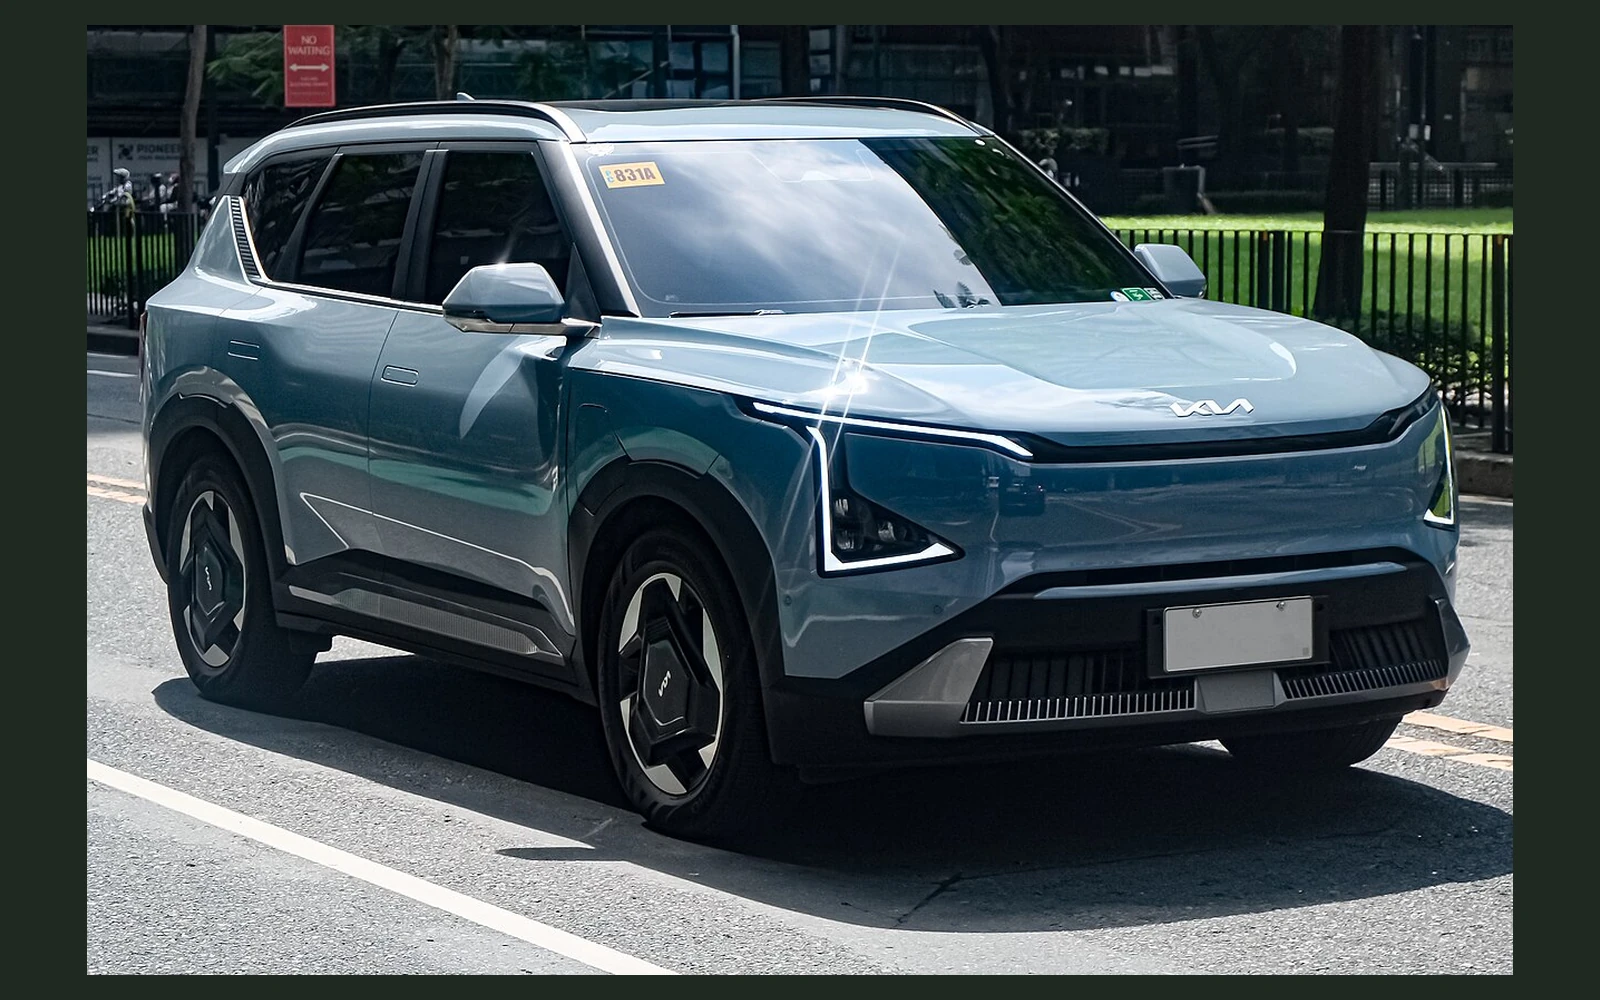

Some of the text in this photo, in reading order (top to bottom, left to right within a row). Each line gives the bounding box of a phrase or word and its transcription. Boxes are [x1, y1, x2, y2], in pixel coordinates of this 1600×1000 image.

[301, 35, 317, 44] NO
[288, 46, 330, 55] WAITING
[614, 167, 656, 182] 831A
[1169, 398, 1255, 418] KIA
